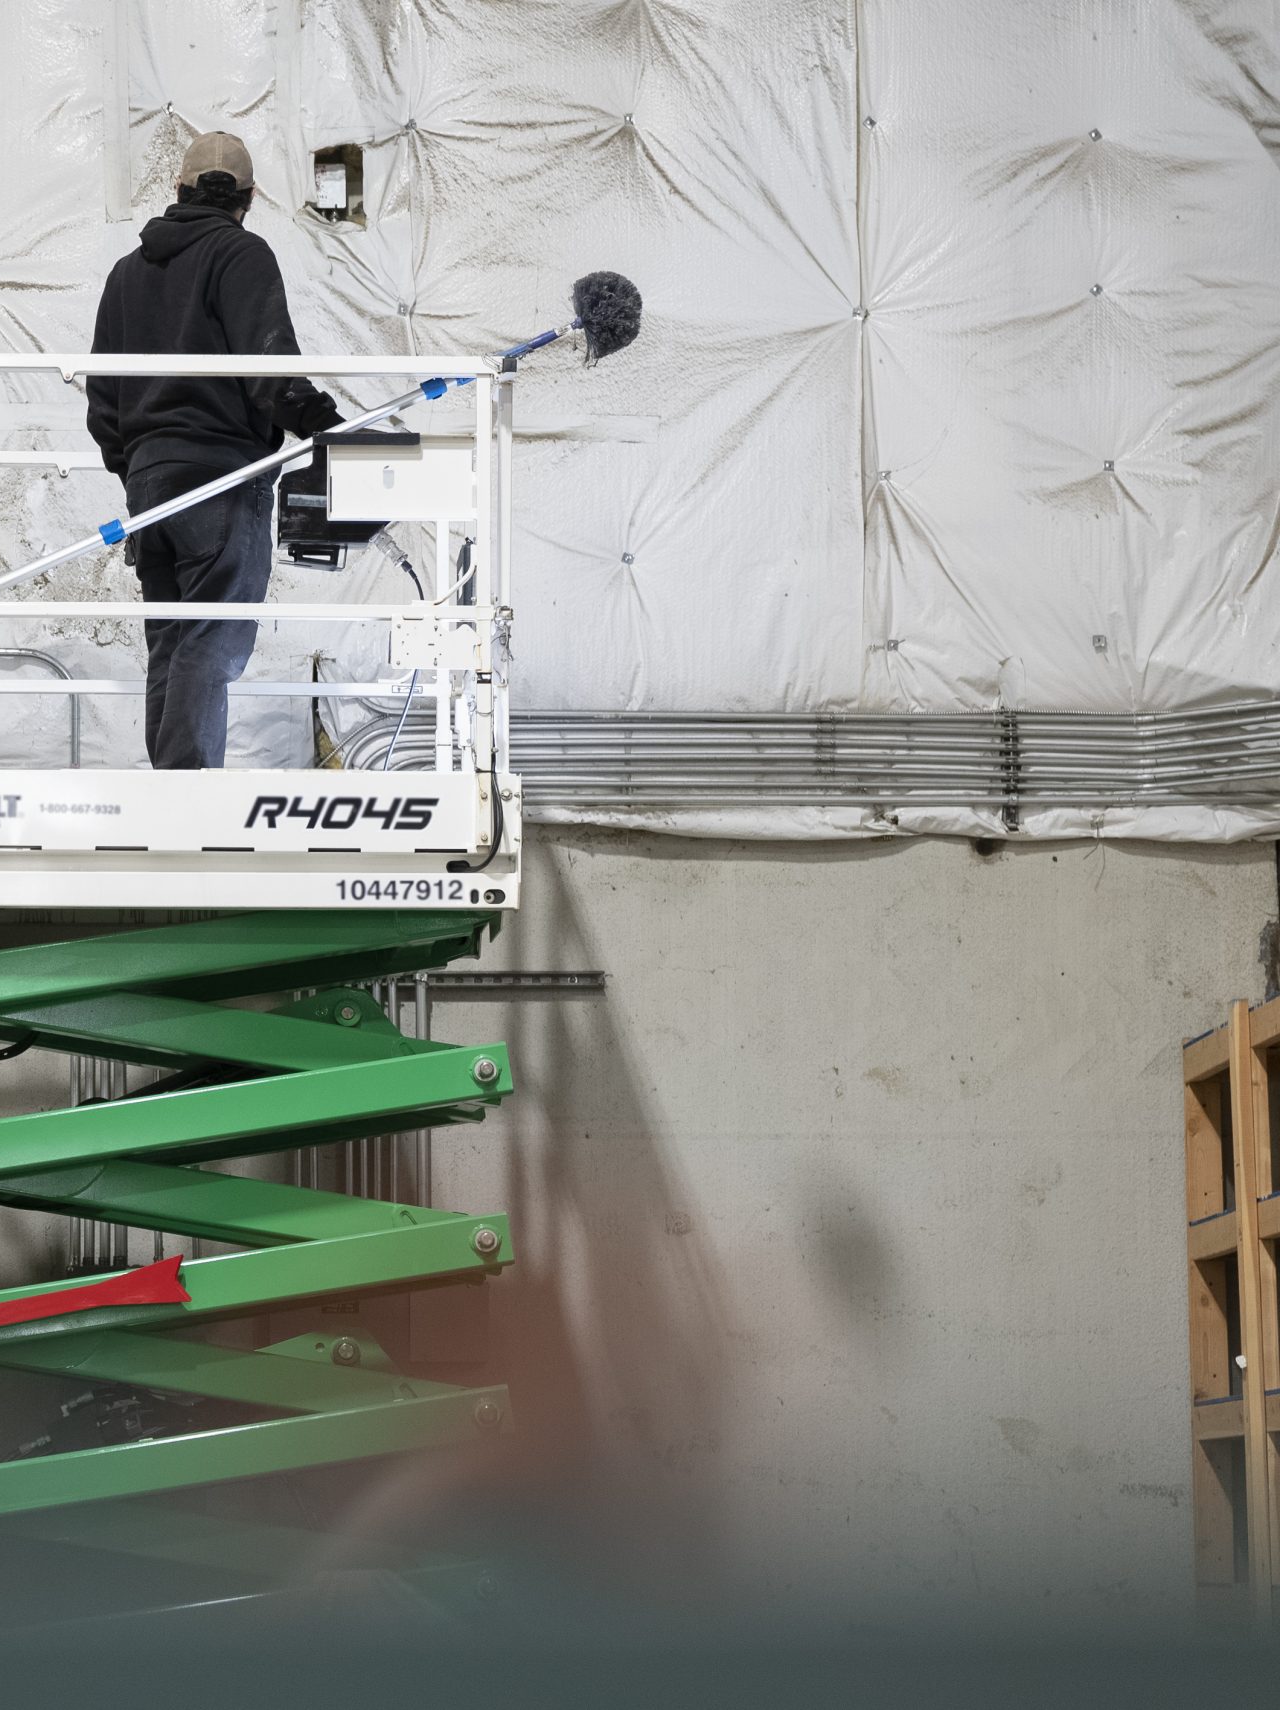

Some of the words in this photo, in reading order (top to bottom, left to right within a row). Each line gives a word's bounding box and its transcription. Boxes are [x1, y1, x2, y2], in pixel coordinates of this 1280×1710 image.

[39, 803, 121, 815] 1-800-667-9328
[244, 796, 440, 830] R4045
[336, 880, 463, 900] 10447912
